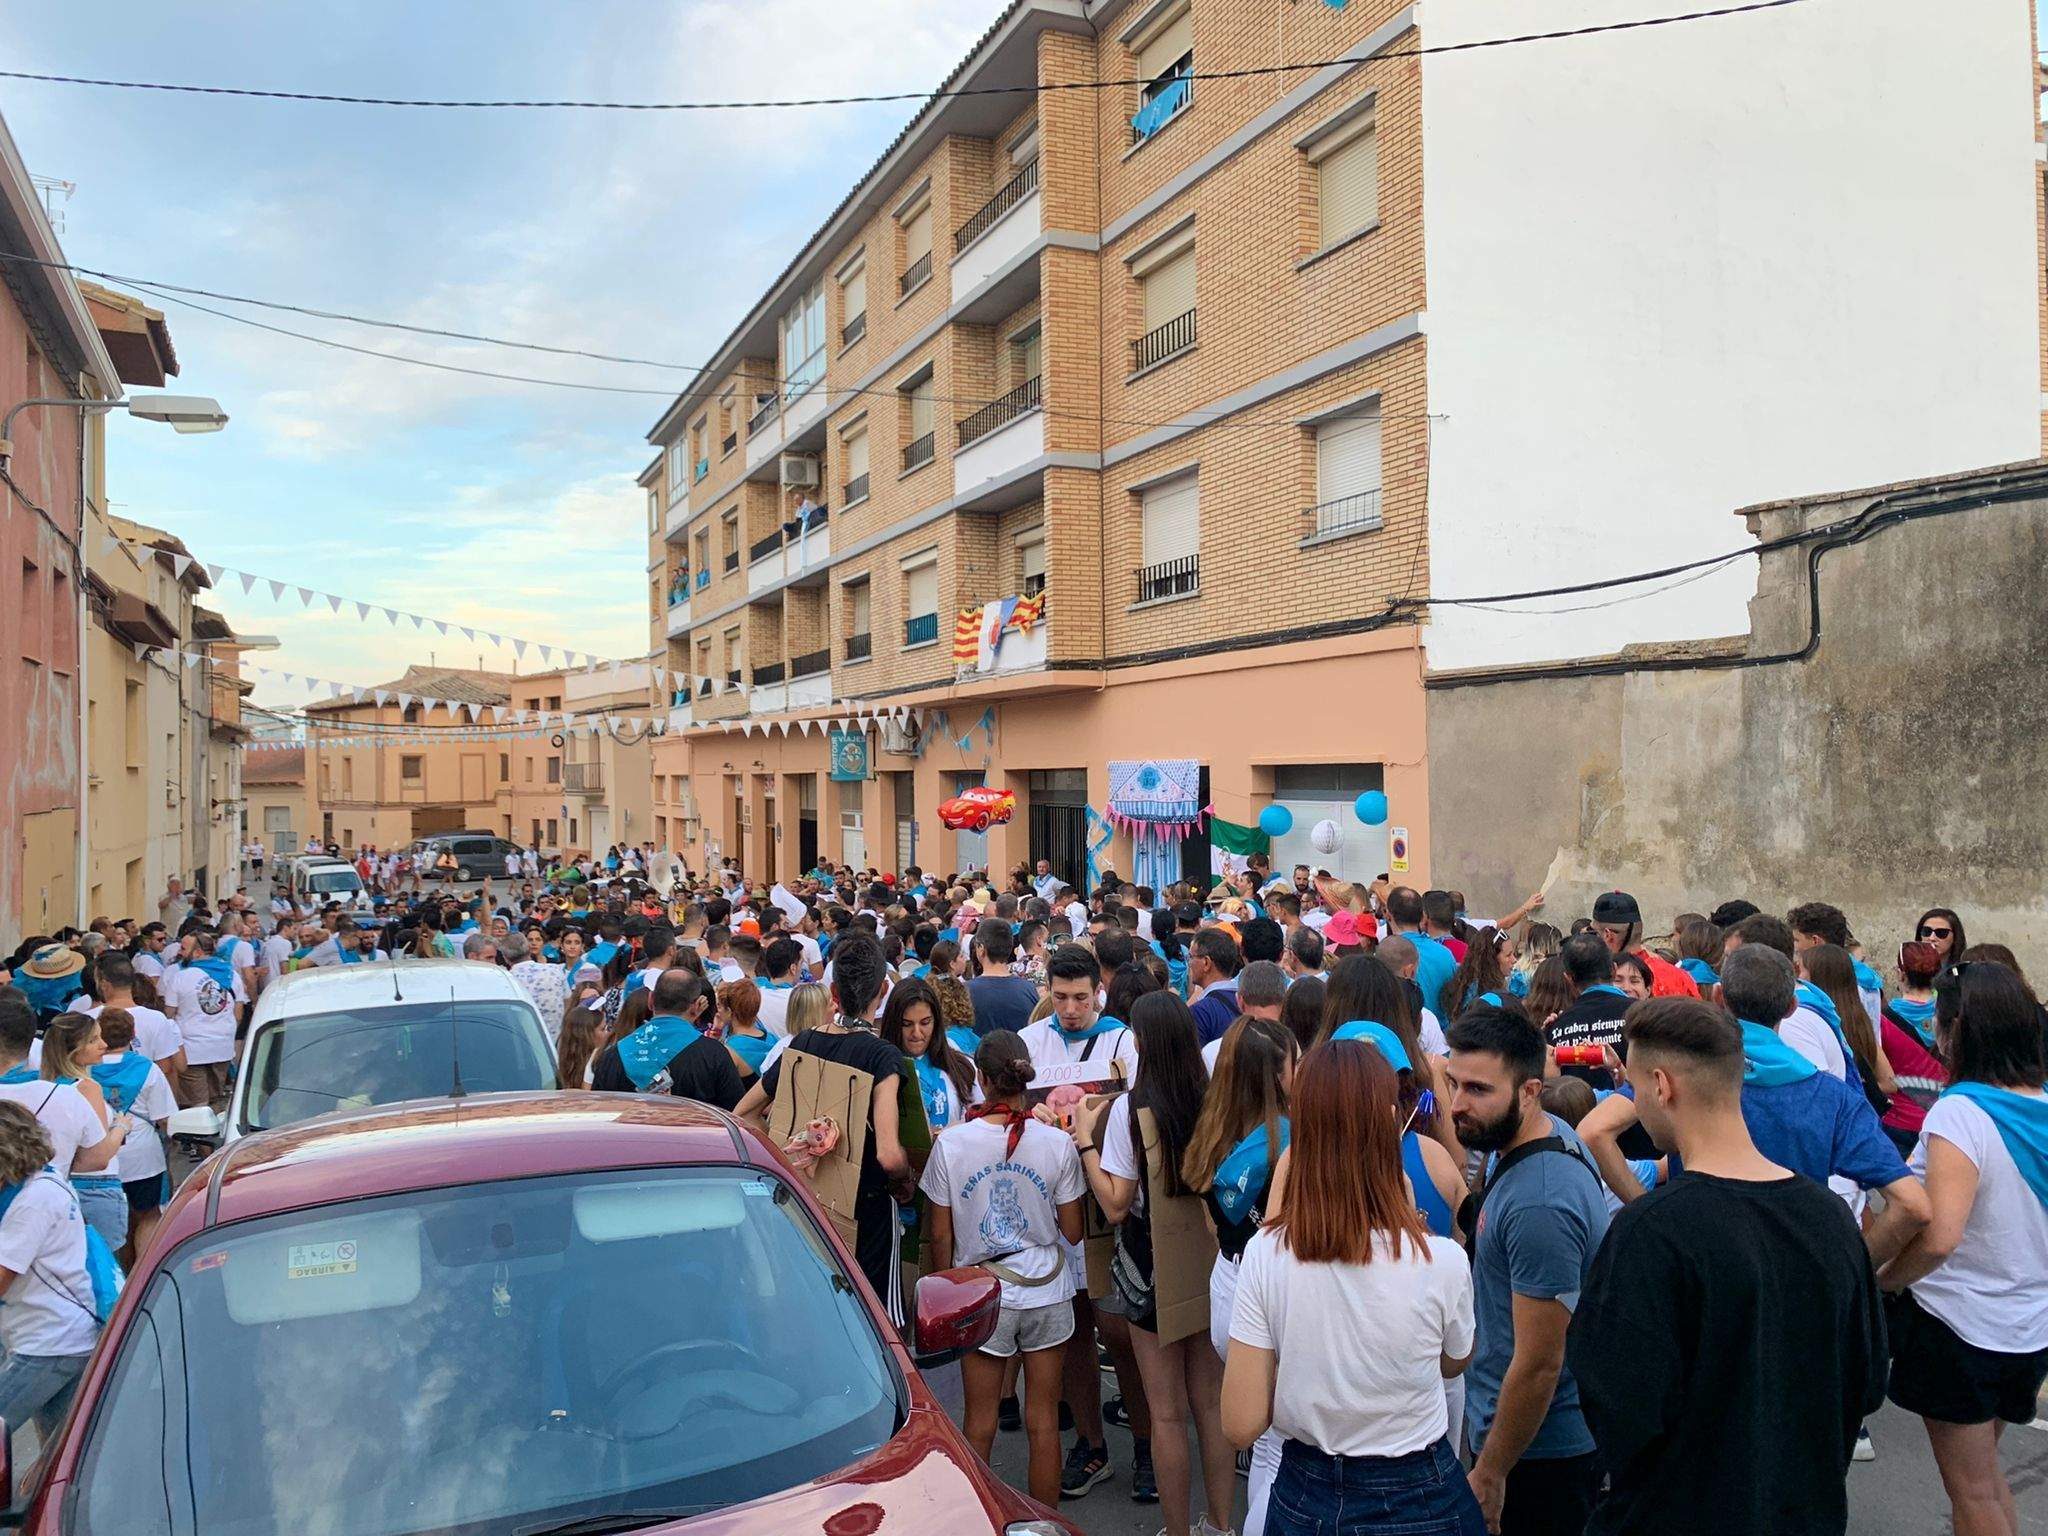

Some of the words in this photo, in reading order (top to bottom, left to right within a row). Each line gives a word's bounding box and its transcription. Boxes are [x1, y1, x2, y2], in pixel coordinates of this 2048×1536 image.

[1564, 1022, 1589, 1035] cabra
[1591, 1019, 1626, 1031] siempr
[1041, 1064, 1082, 1083] 2003
[296, 1265, 337, 1277] AIRBAG
